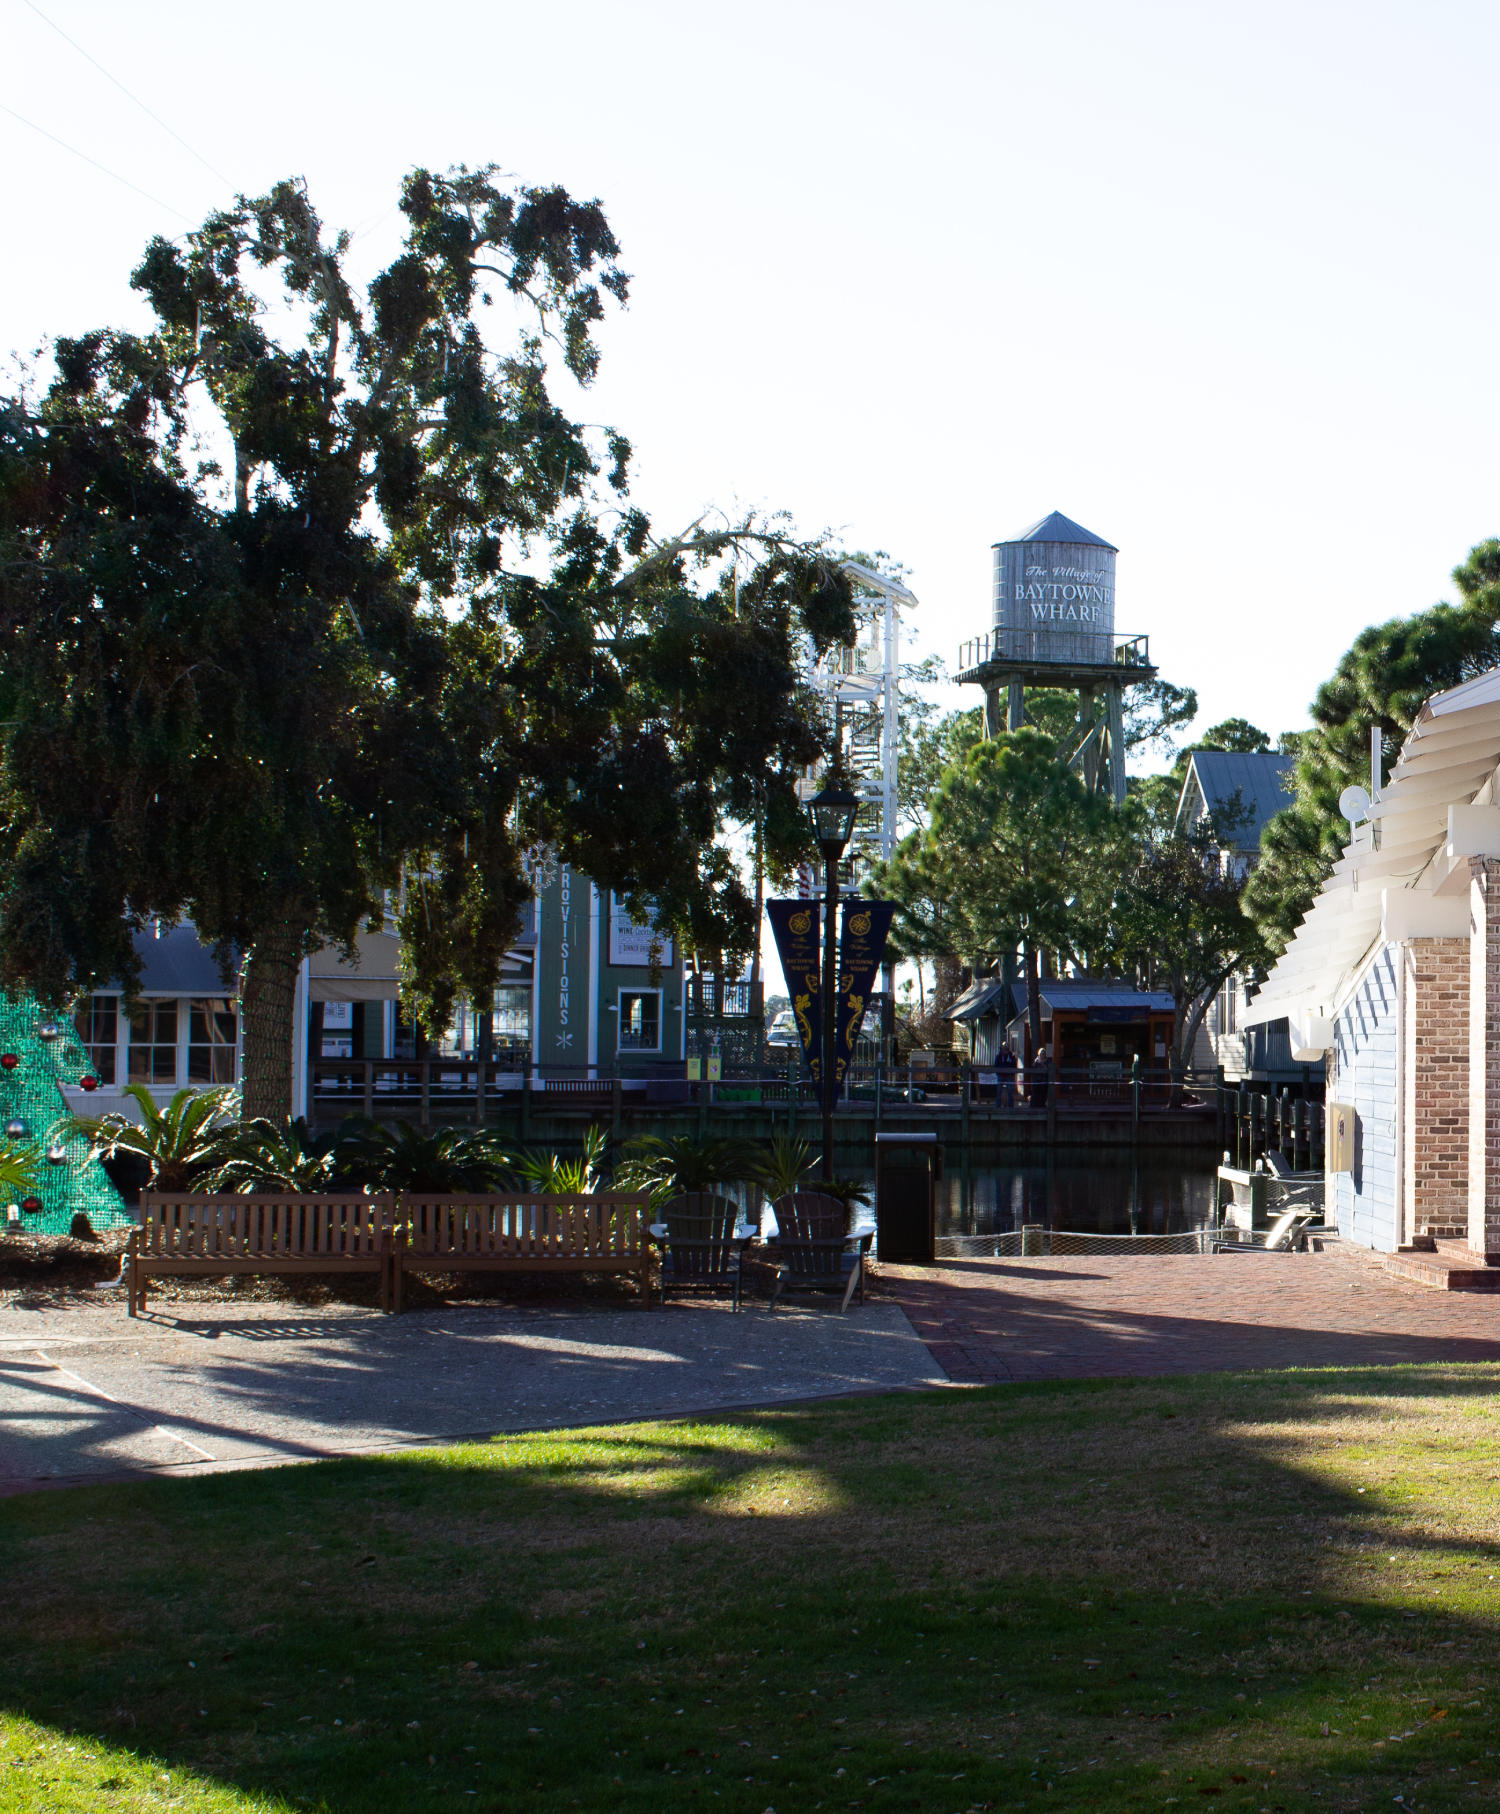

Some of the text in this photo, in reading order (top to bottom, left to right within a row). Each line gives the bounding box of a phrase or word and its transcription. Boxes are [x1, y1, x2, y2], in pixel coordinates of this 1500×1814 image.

[1025, 566, 1105, 583] The Village of
[1015, 584, 1110, 604] BAYTOWNE
[1031, 604, 1101, 621] WHARF
